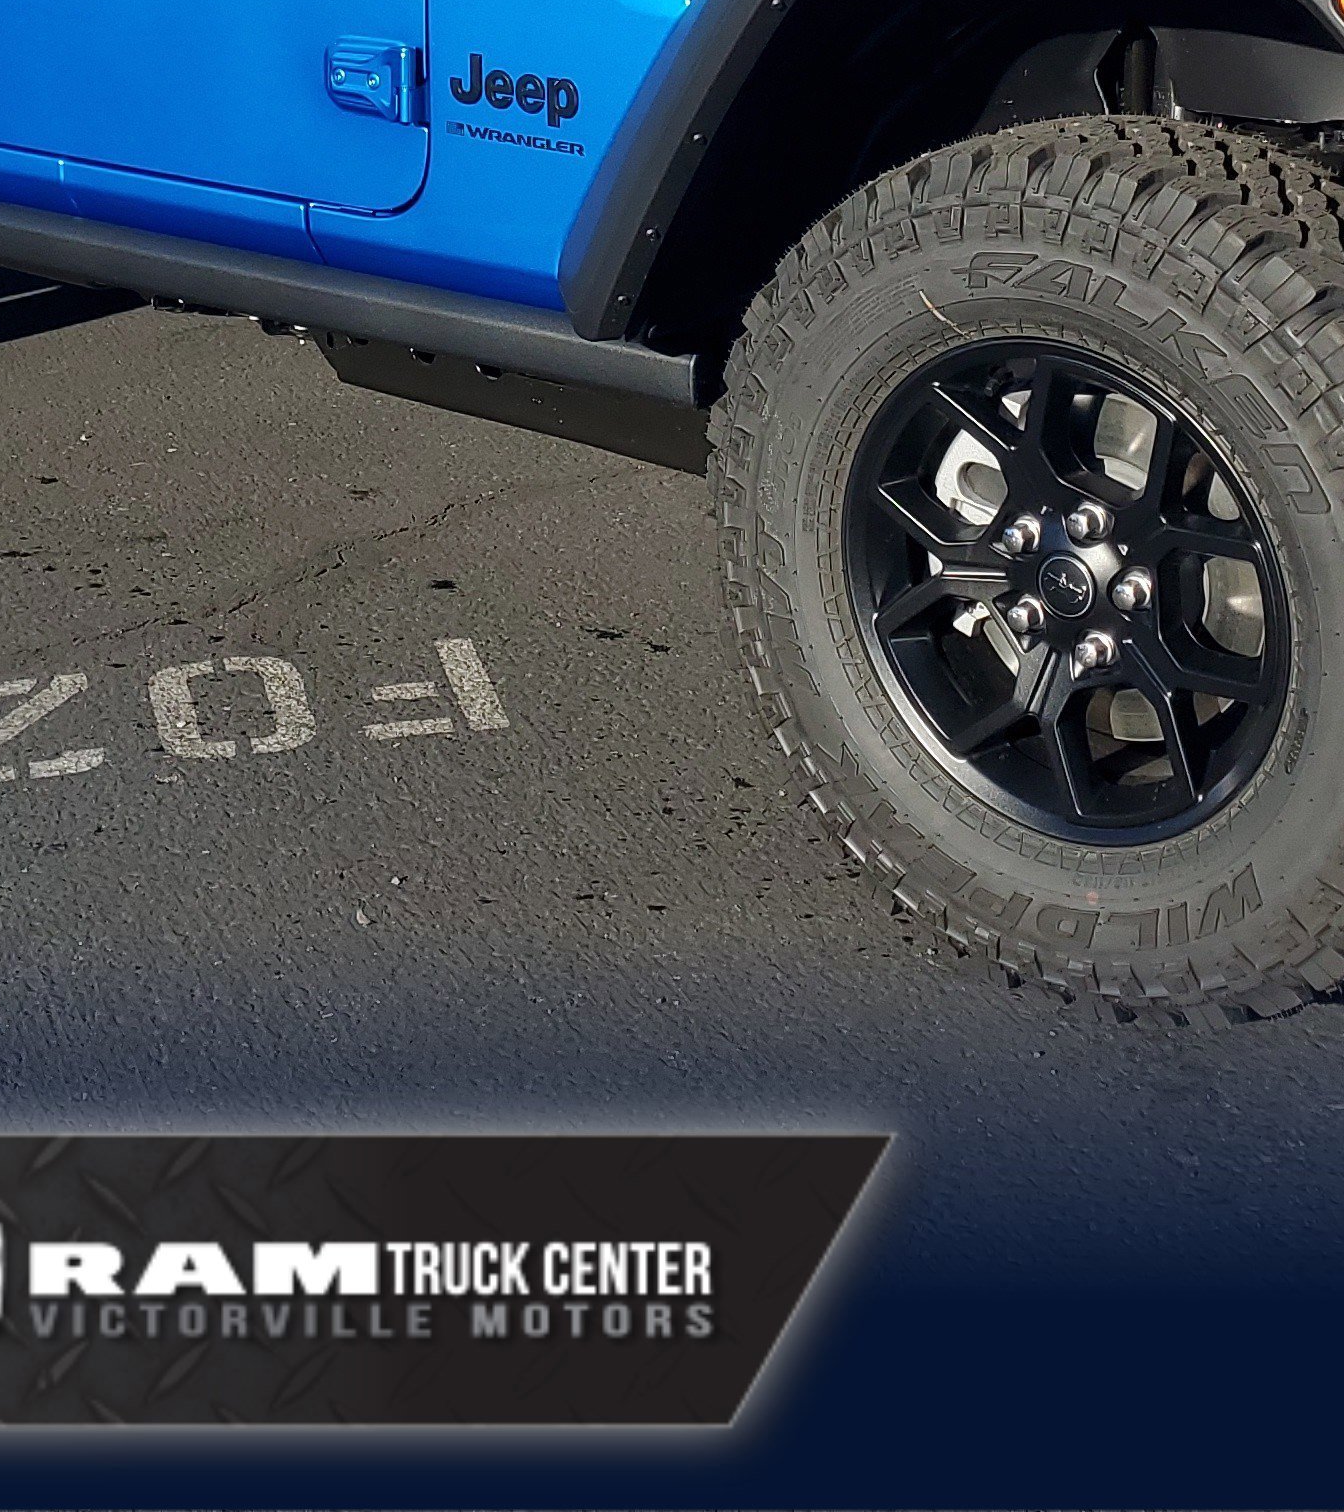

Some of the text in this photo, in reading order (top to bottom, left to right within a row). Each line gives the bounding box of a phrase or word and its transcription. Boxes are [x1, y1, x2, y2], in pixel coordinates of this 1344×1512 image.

[449, 53, 579, 128] Jeep
[466, 123, 586, 156] WRANGLER
[951, 252, 1333, 515] FALKEN
